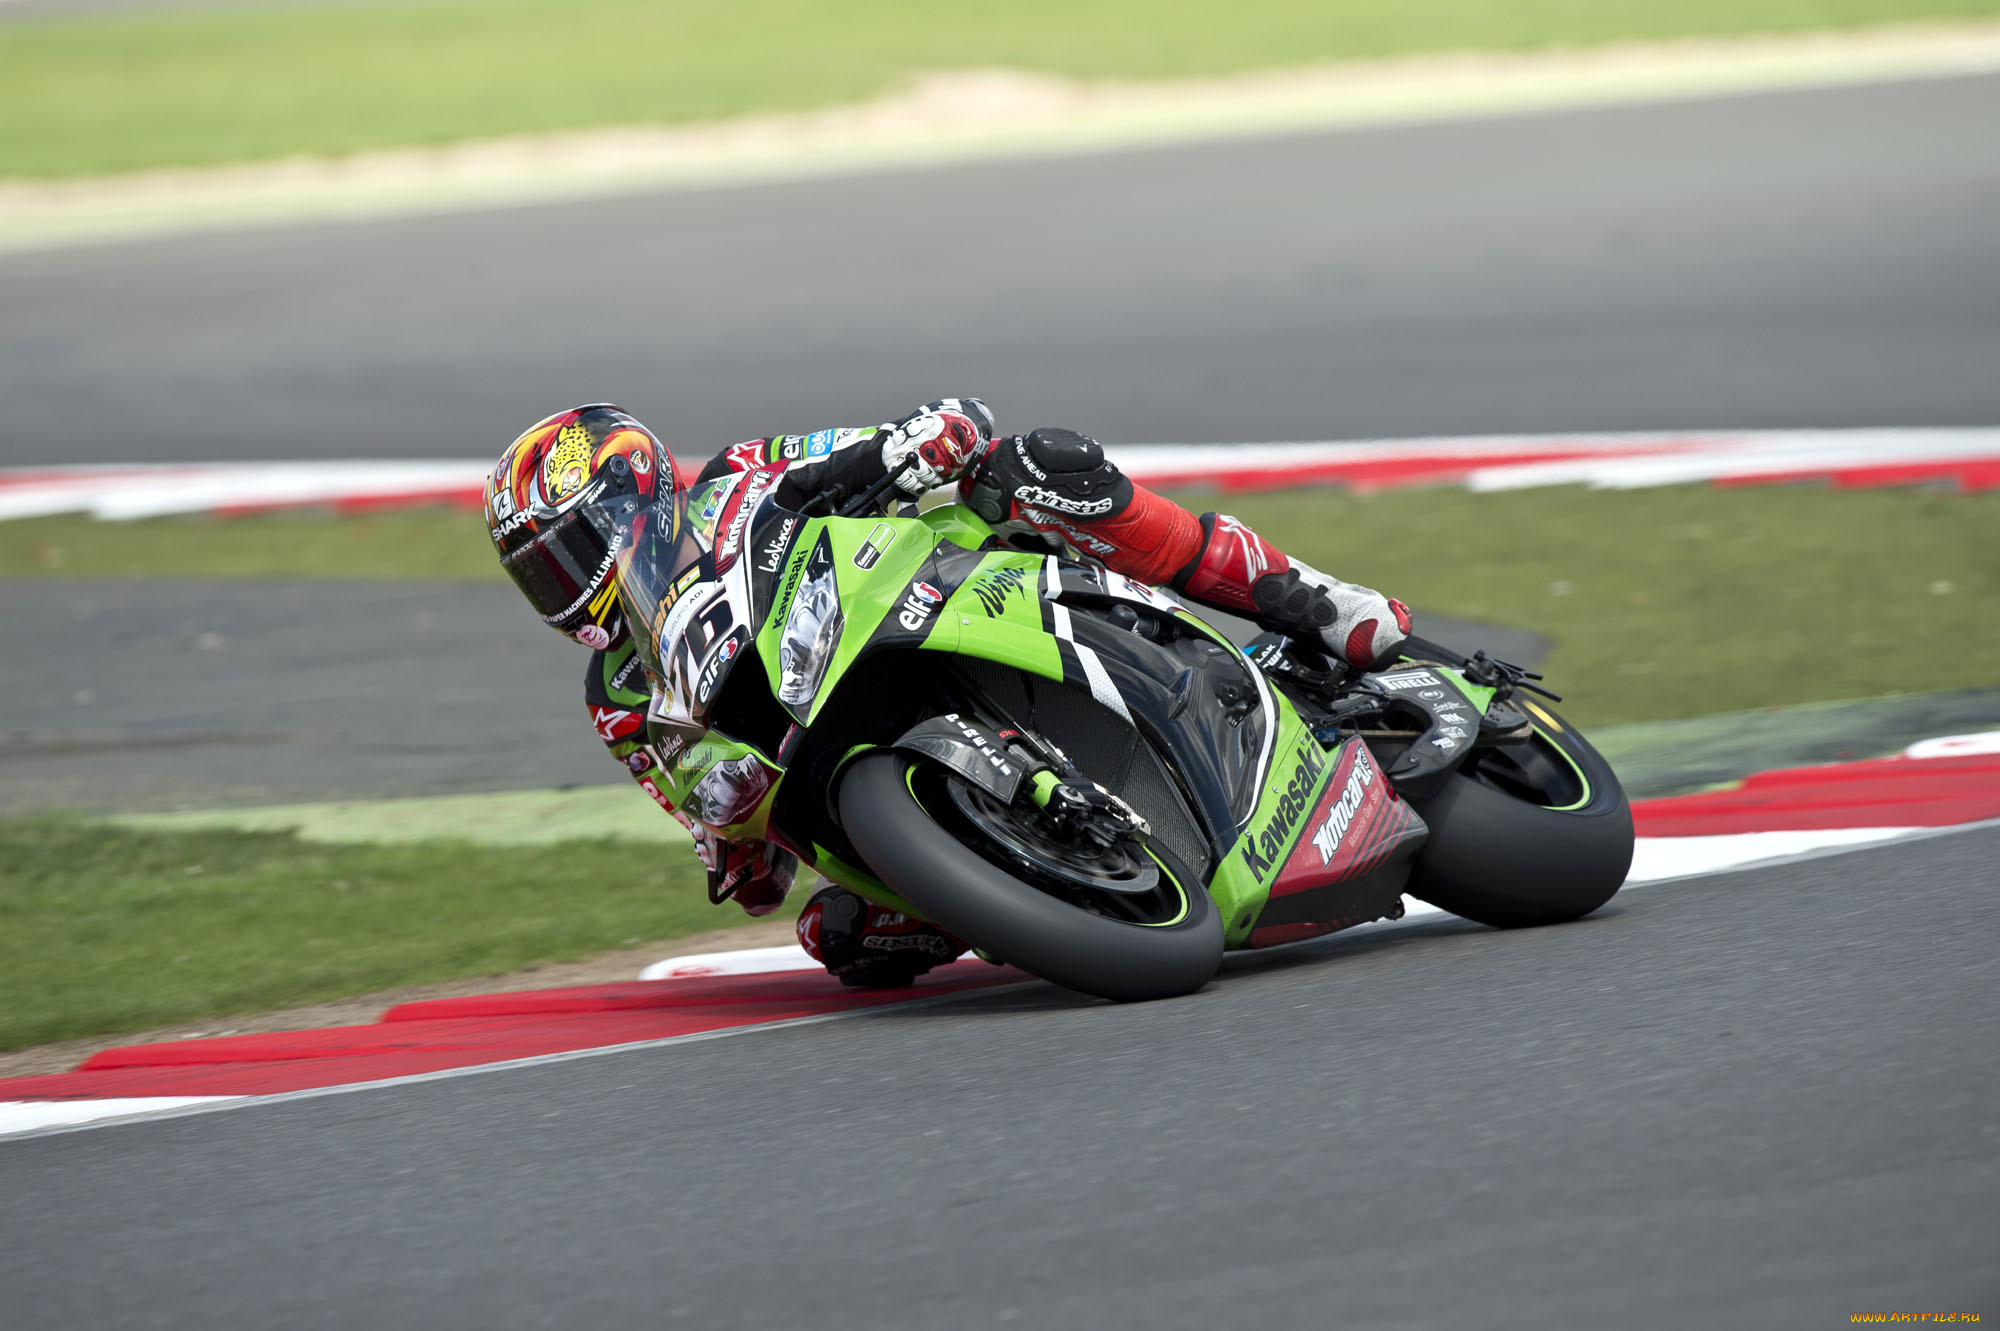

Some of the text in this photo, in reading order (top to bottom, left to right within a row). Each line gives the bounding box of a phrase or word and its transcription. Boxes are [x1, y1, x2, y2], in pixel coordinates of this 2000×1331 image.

[1020, 455, 1047, 482] AHEAD
[491, 502, 541, 543] SHARK
[1014, 485, 1113, 515] alpinestars
[758, 517, 794, 574] LeoVince
[563, 587, 594, 617] MACHINES
[590, 535, 623, 590] ALLIMAND
[772, 550, 809, 630] Kawasaki
[971, 566, 1027, 619] Ninja
[668, 589, 704, 638] GRUPO ADI
[899, 595, 932, 632] elf
[700, 661, 720, 704] elf
[1375, 671, 1442, 691] PIRELLI
[1241, 732, 1326, 885] Kawasaki
[1311, 746, 1374, 868] Motocard
